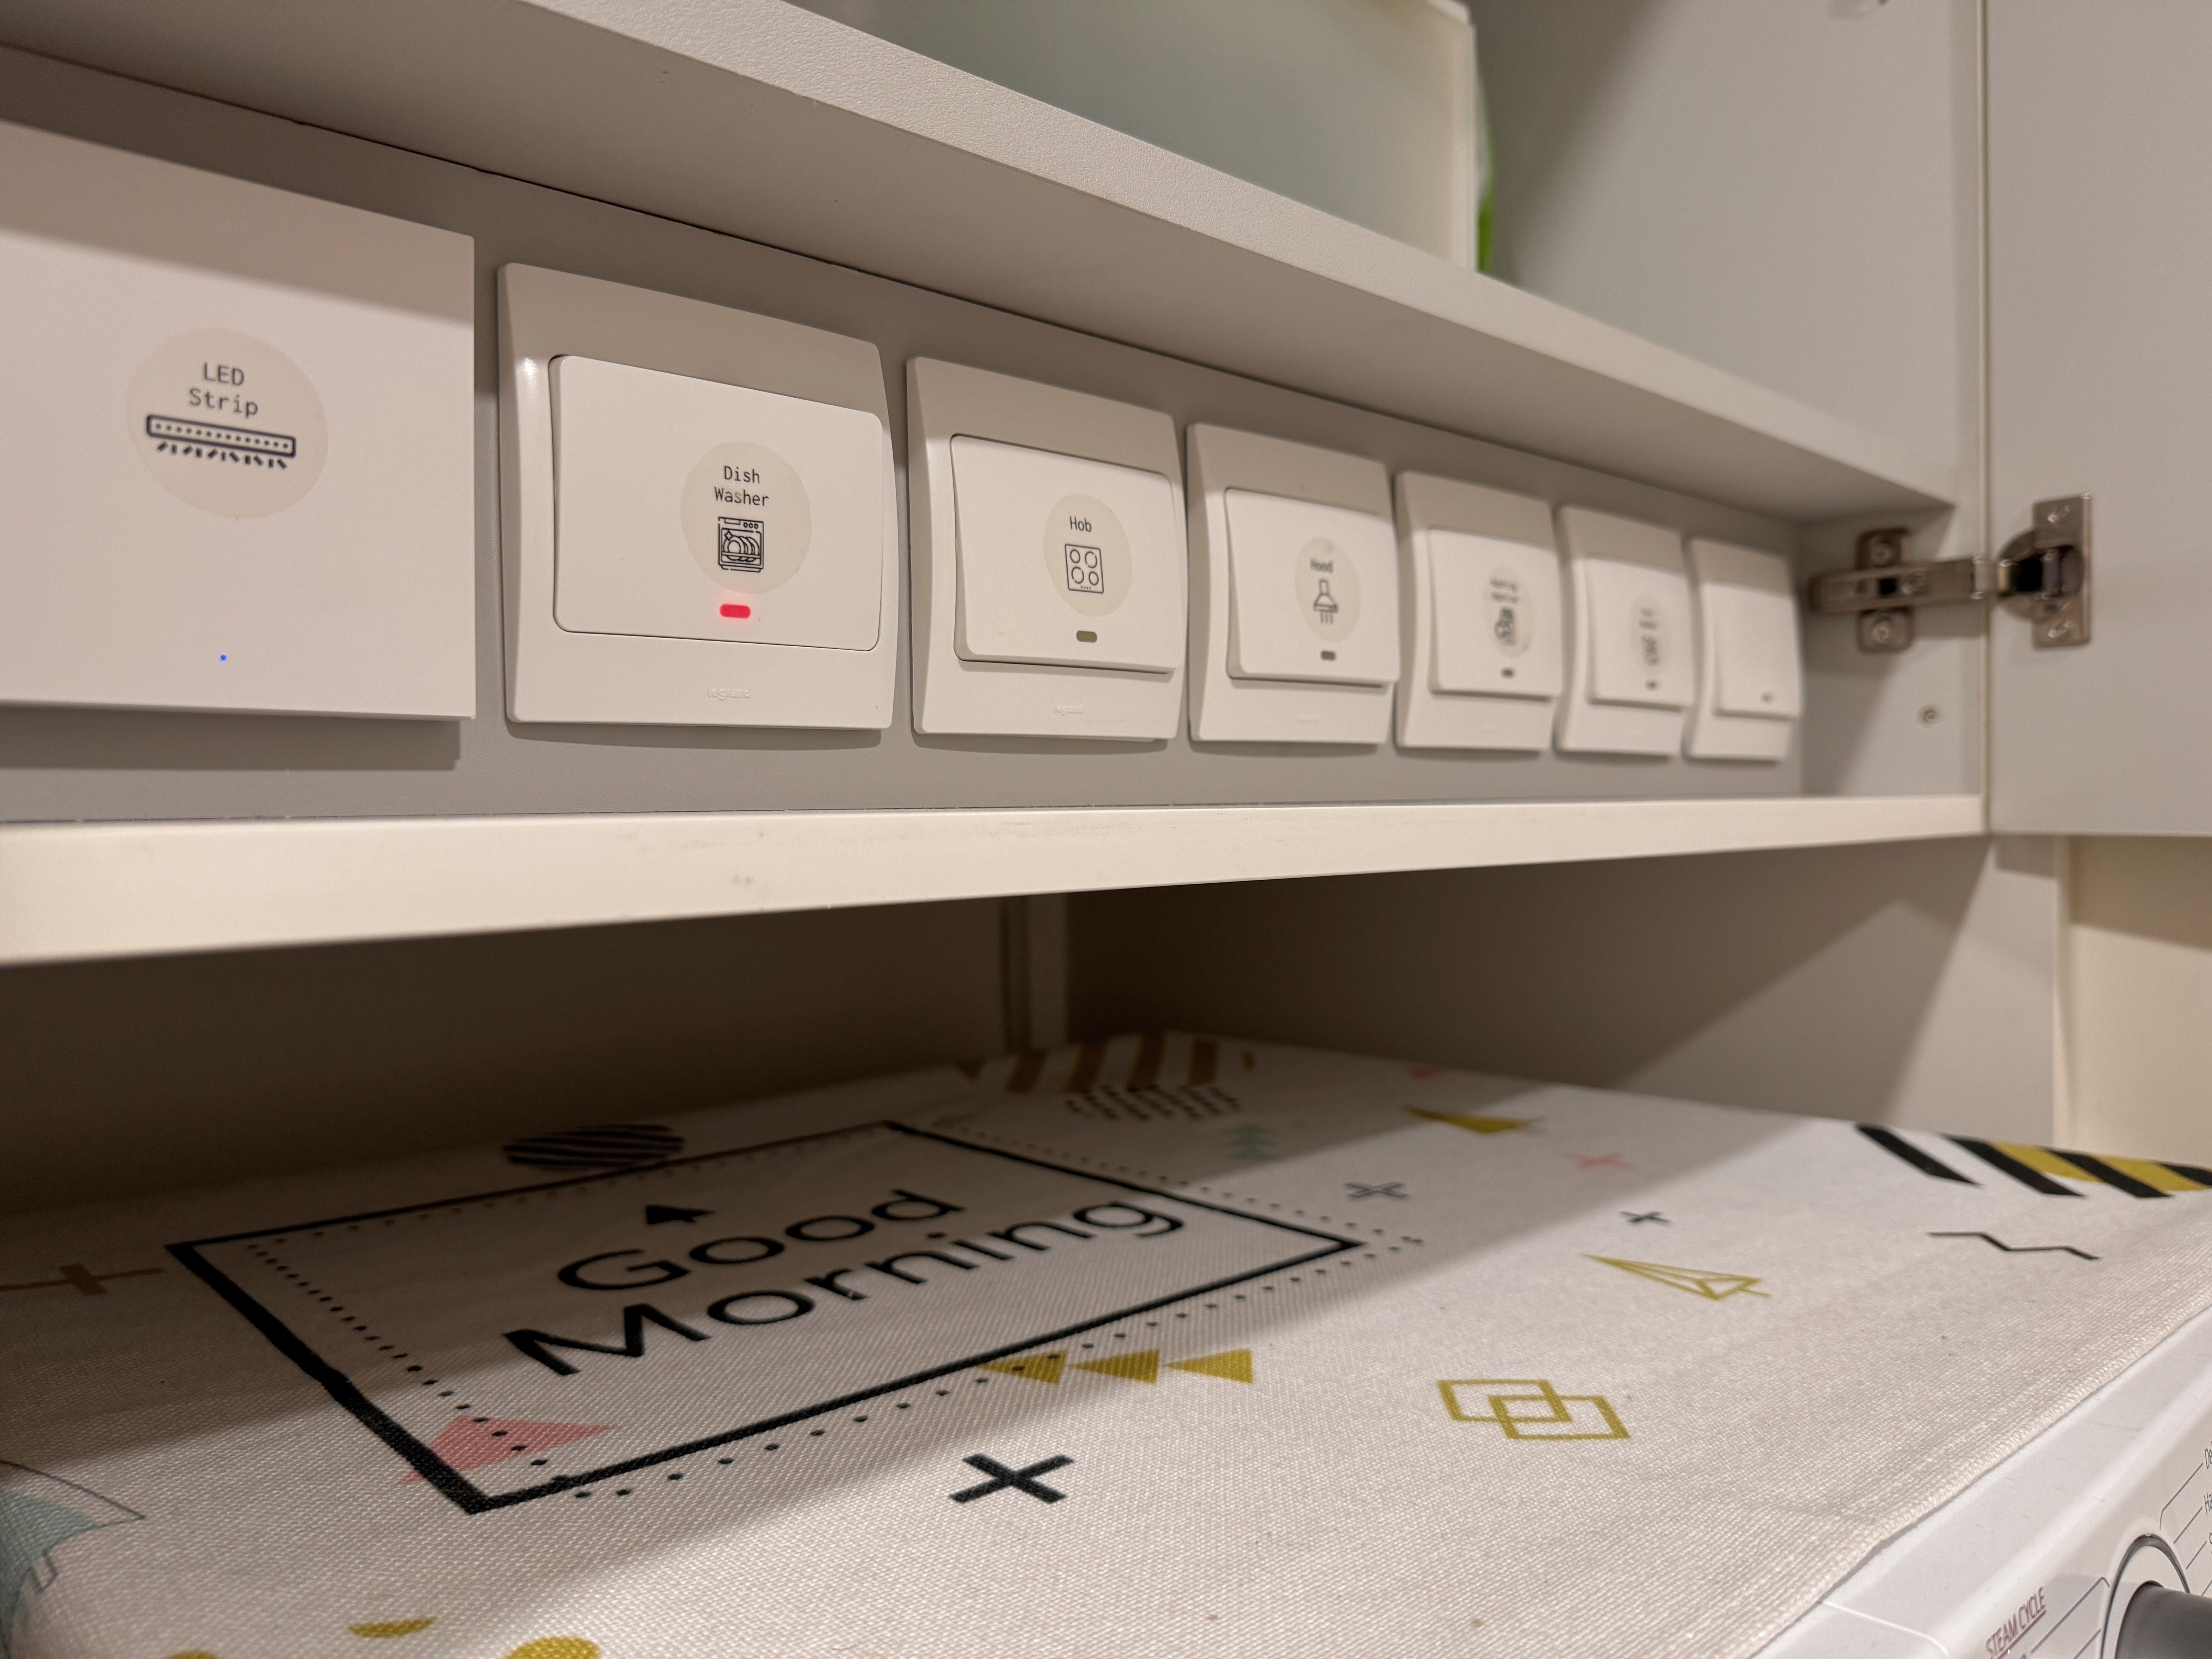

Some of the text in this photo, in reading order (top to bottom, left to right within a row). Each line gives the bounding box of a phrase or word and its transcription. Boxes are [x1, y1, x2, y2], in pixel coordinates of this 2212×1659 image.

[203, 362, 245, 386] LED
[189, 387, 259, 419] Strip
[724, 465, 760, 484] Dish
[714, 486, 769, 507] Washer
[1069, 516, 1092, 532] Hob
[558, 1189, 967, 1290] Good
[502, 1199, 1185, 1376] Morning
[1985, 1586, 2046, 1659] STEAM CYCLE
